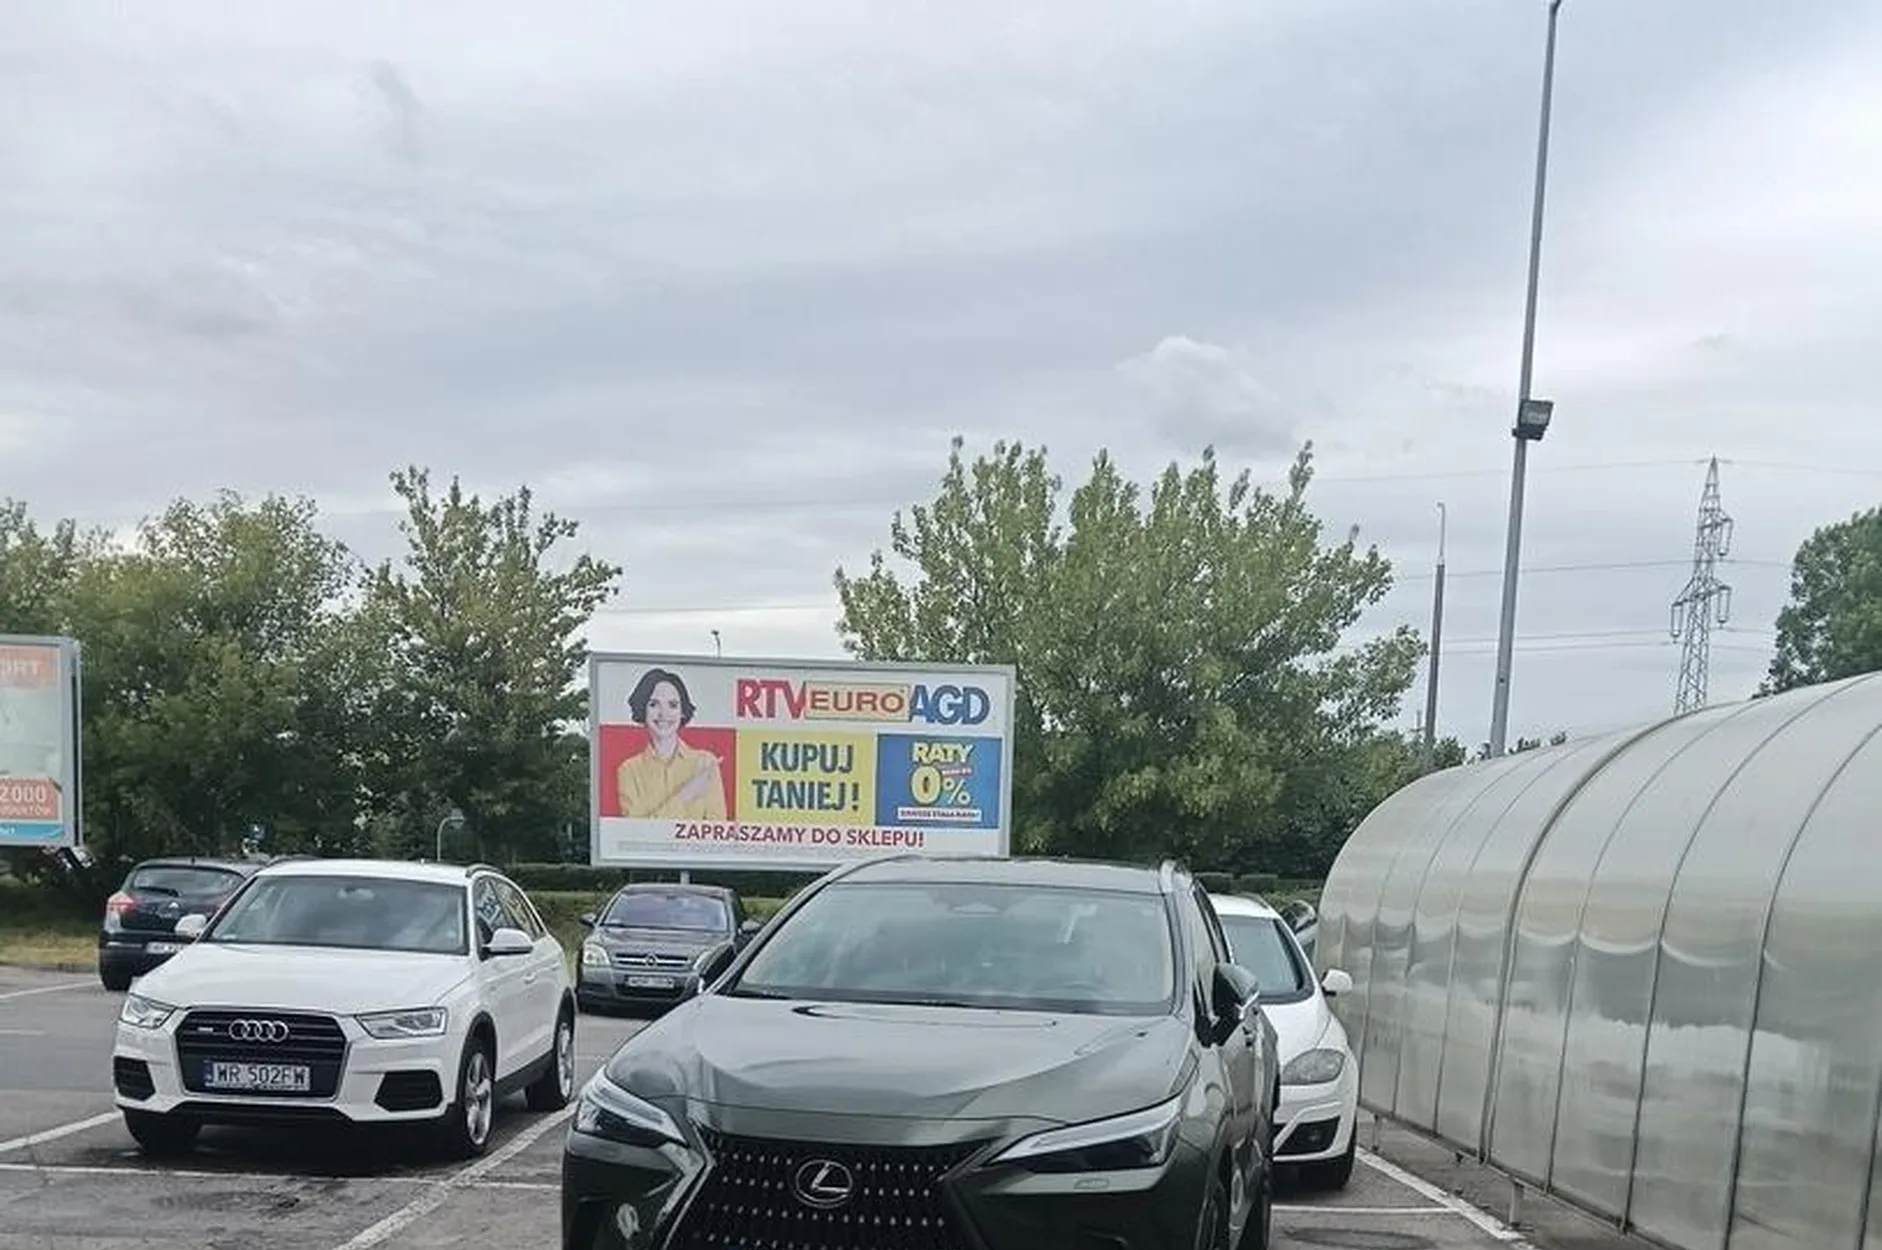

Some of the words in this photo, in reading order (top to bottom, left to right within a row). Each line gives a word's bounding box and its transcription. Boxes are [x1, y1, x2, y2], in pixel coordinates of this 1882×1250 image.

[737, 679, 806, 719] RTV
[810, 688, 905, 713] EURO
[909, 685, 990, 725] AGD
[761, 742, 853, 773] KUPUJ
[912, 741, 974, 764] RATY
[675, 823, 808, 843] ZAPRASZAMY
[812, 829, 841, 844] DO
[846, 829, 925, 847] SKLEPU!
[217, 1064, 240, 1082] WR
